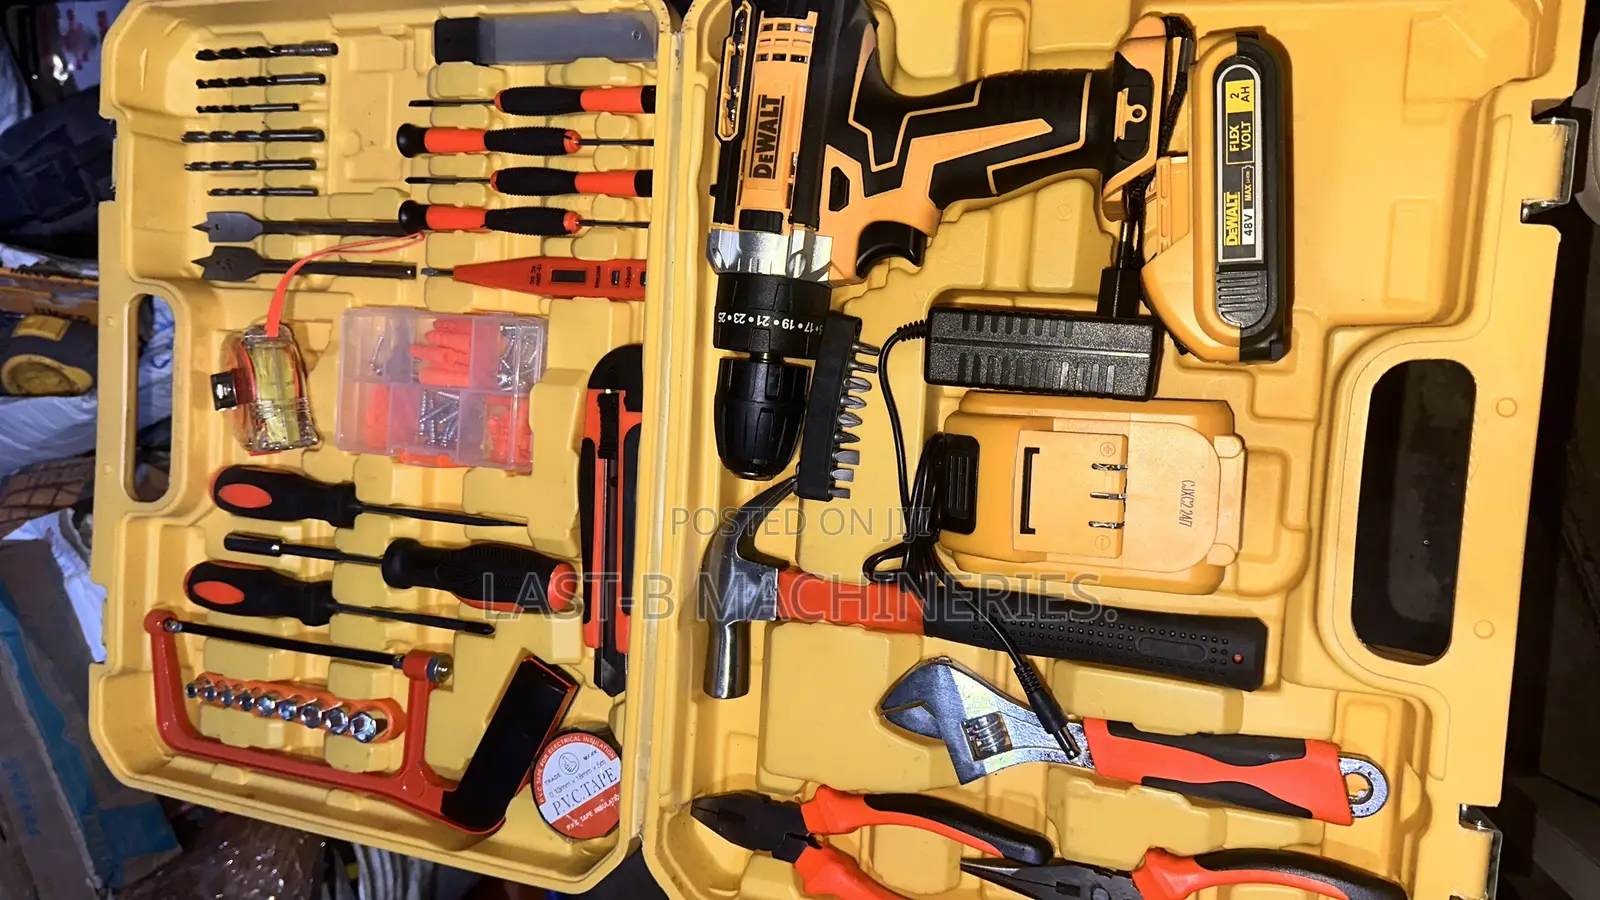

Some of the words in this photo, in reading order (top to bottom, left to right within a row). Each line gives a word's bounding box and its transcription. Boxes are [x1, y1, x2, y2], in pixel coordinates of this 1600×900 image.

[1241, 86, 1250, 102] AH
[1229, 125, 1239, 152] FLEX
[1241, 121, 1251, 151] VOLT
[1243, 213, 1253, 237] 48V
[718, 312, 726, 323] 25
[733, 313, 746, 324] 23
[756, 315, 770, 327] 21
[781, 318, 795, 330] 19
[804, 322, 814, 333] 17
[540, 757, 548, 768] FOR
[548, 735, 581, 755] ELECTRICAL
[582, 736, 616, 760] INSULATION
[596, 759, 607, 769] 5m
[544, 772, 562, 786] TRADE
[580, 811, 593, 823] TAPE
[594, 793, 620, 814] INSULATIO
